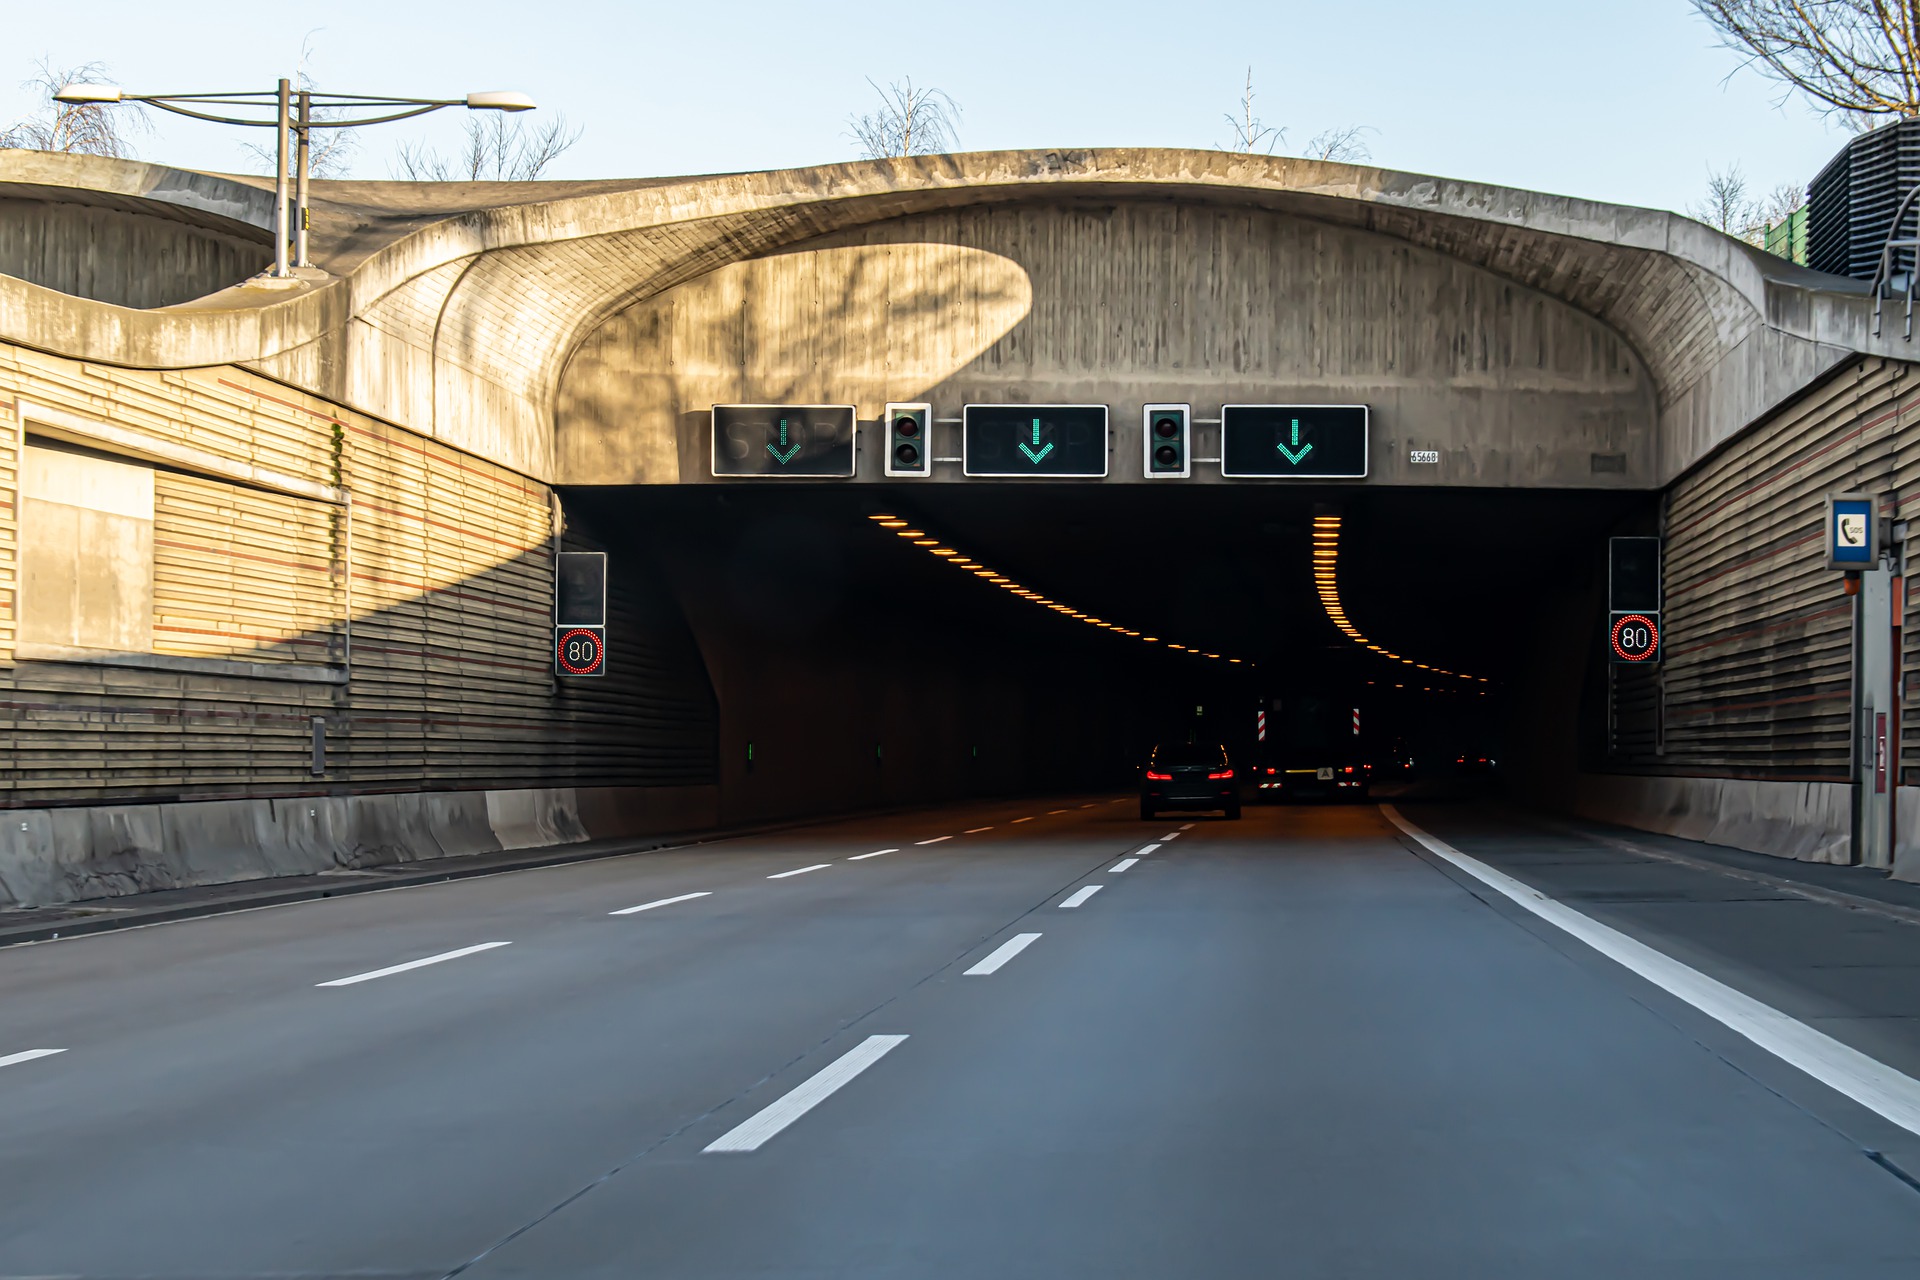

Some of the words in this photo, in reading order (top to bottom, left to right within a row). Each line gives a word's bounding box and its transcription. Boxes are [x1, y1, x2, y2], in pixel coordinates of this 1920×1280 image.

[1411, 452, 1436, 462] 65668
[1849, 526, 1864, 534] SOS
[1622, 627, 1647, 648] 80
[569, 641, 593, 661] 80
[1321, 769, 1330, 778] A
